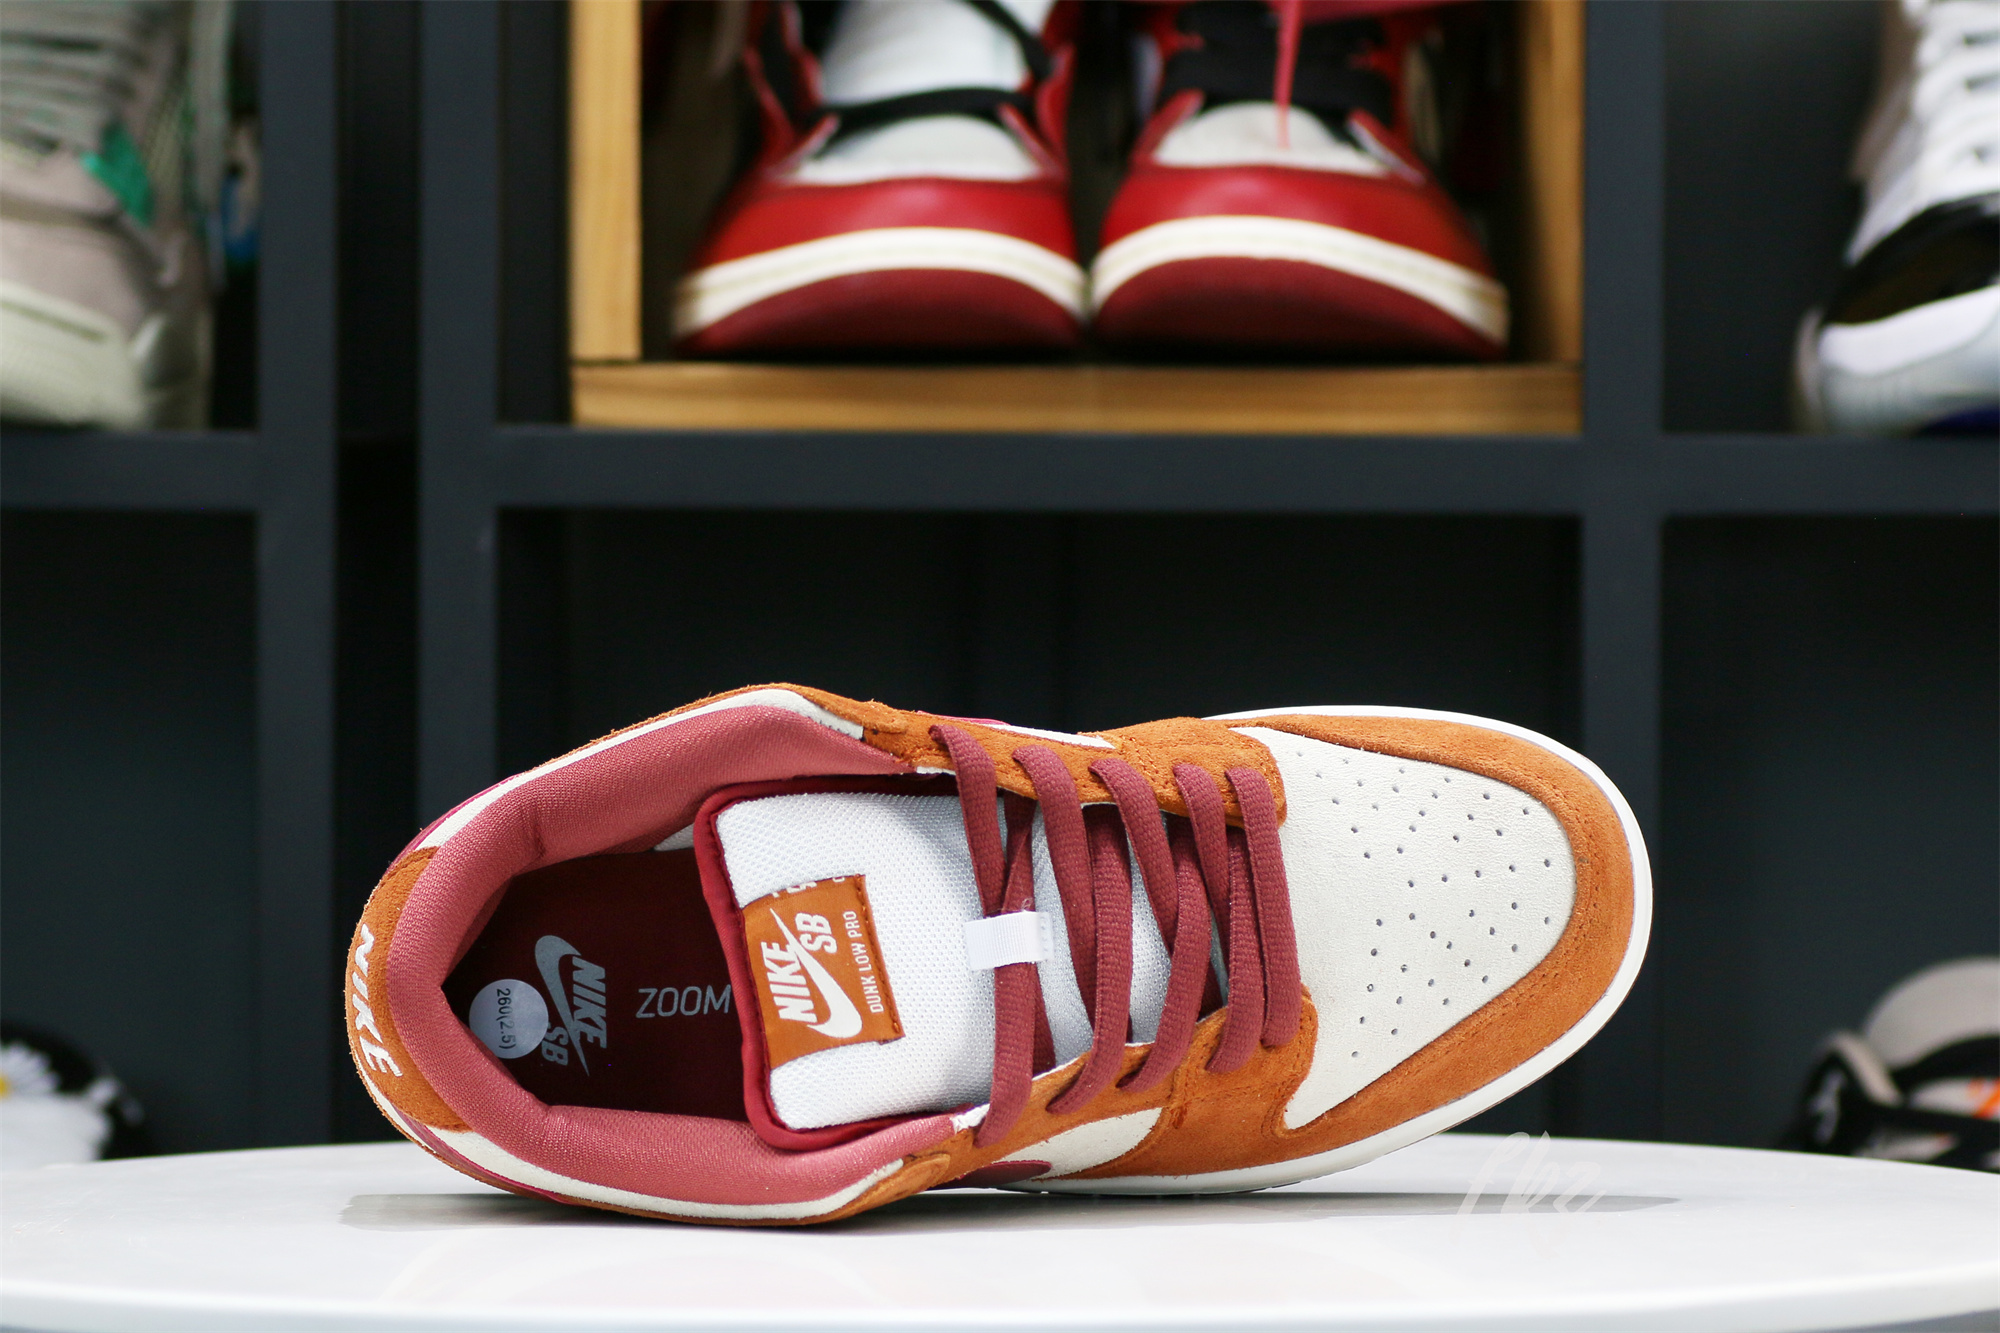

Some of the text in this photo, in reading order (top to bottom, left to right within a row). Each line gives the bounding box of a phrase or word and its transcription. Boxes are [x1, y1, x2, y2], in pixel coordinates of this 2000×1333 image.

[794, 911, 838, 954] SB
[842, 910, 885, 1014] DUNK LOW PRO
[352, 923, 403, 1077] NIKE
[572, 956, 608, 1049] NIKE
[635, 983, 732, 1019] ZOOM
[761, 941, 818, 1023] NIKE
[541, 1021, 569, 1067] SB
